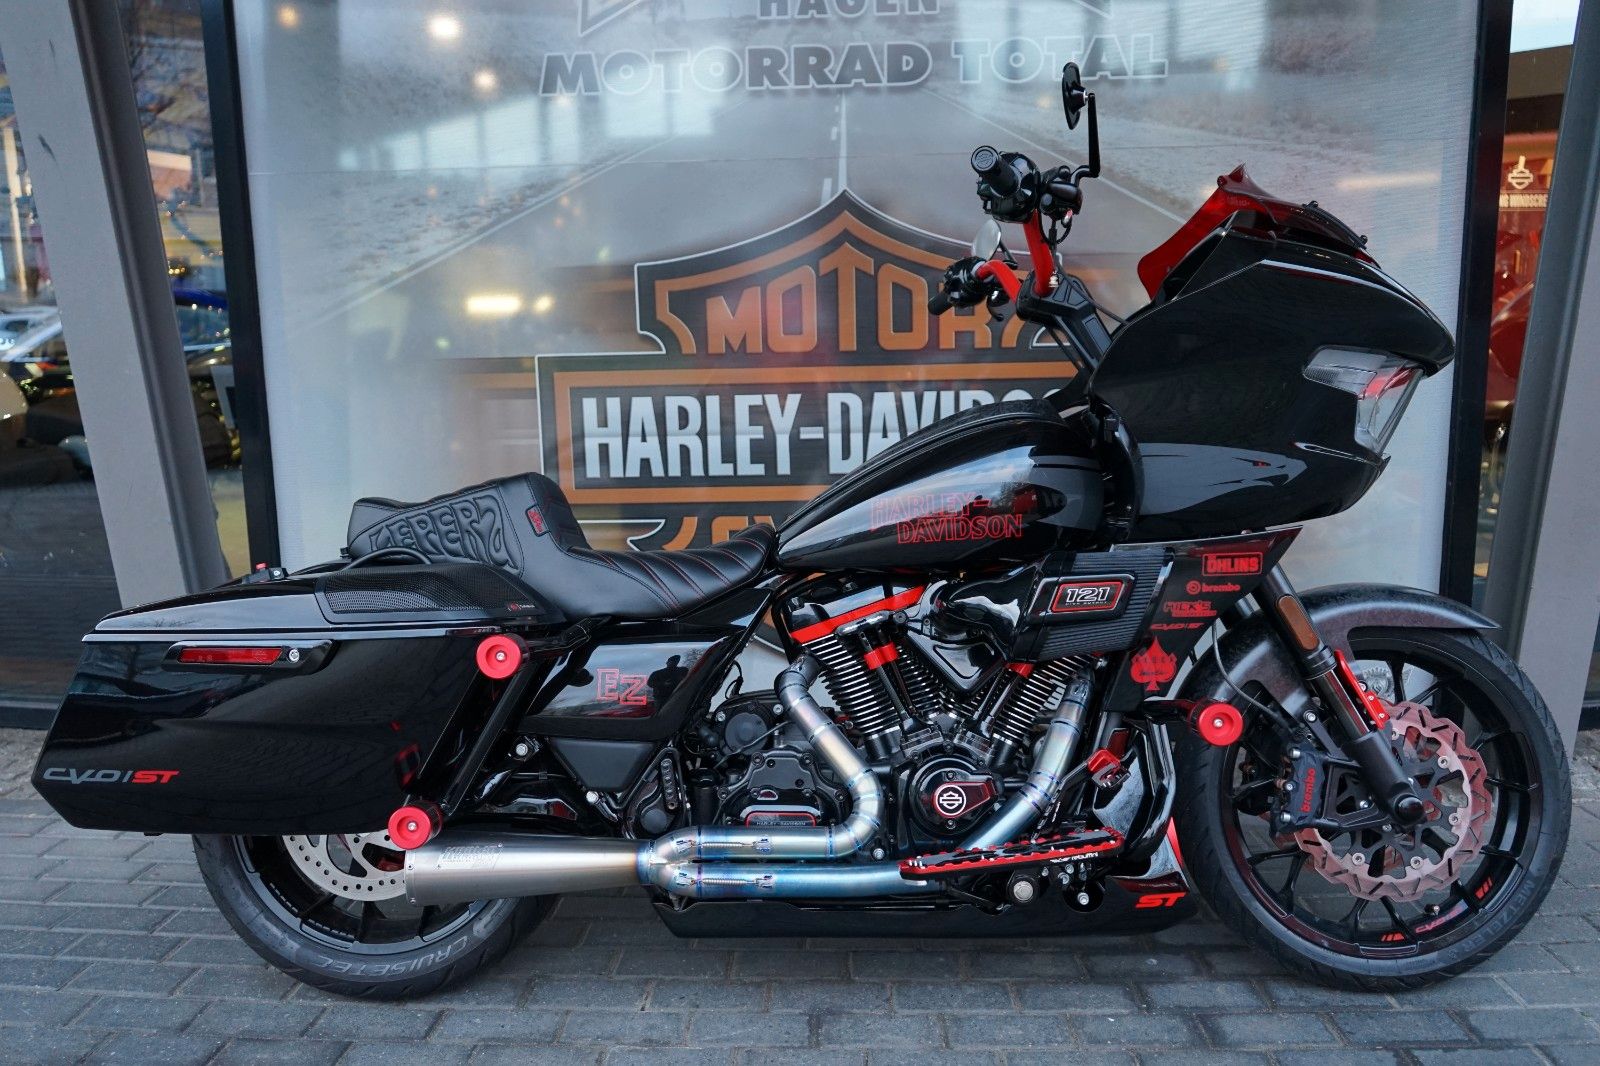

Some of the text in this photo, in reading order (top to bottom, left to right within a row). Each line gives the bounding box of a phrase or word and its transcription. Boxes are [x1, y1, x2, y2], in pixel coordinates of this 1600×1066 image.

[539, 34, 1169, 96] MOTORRAD TOTAL
[706, 242, 992, 353] MOTOR
[897, 514, 1023, 544] DAVIDSON
[1066, 587, 1111, 603] 121
[1301, 768, 1316, 812] brembo
[1135, 892, 1187, 908] ST
